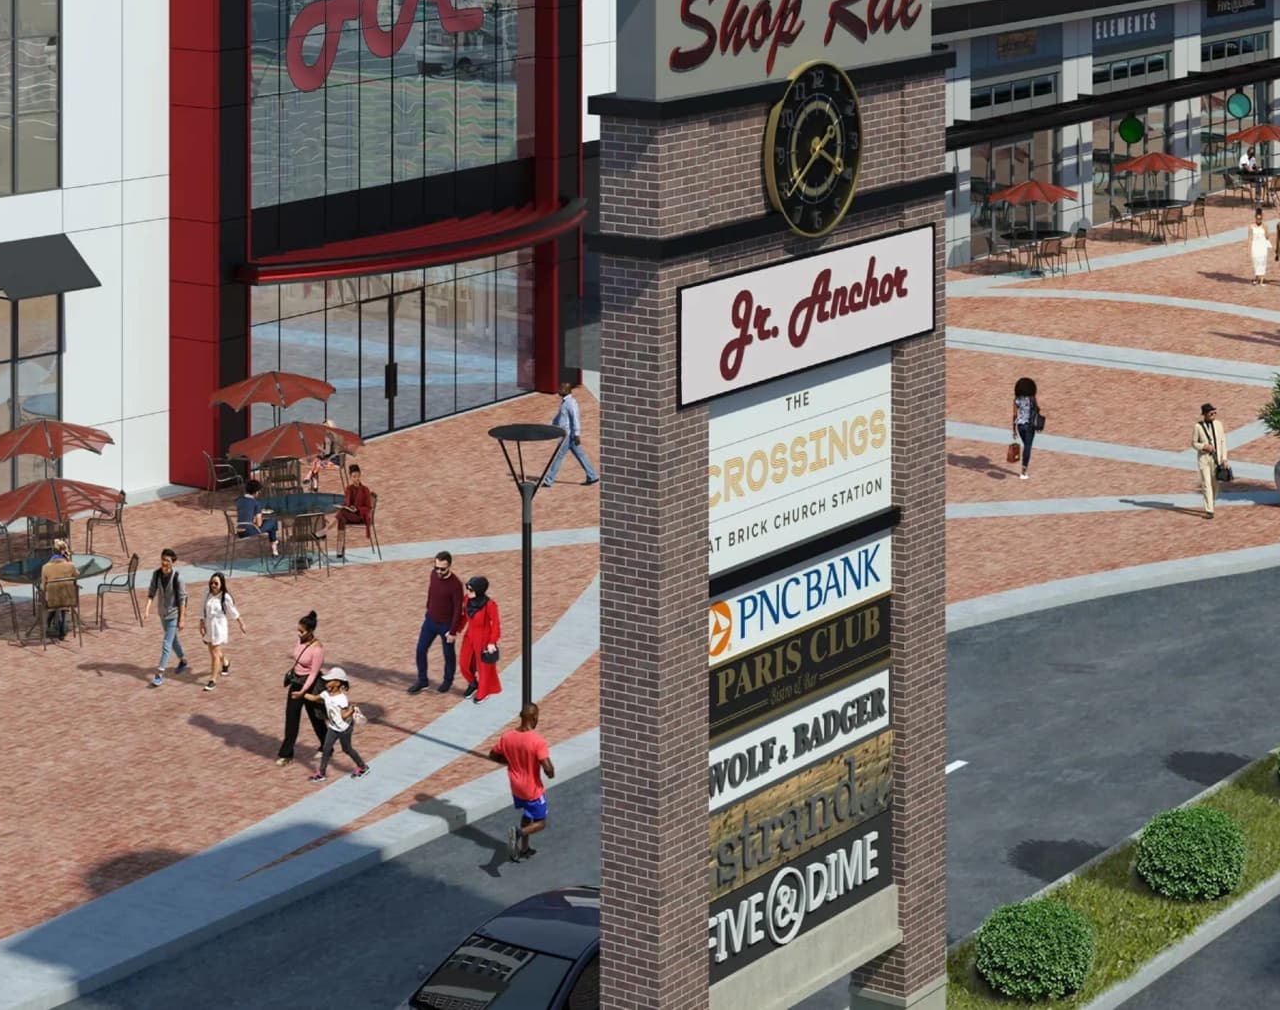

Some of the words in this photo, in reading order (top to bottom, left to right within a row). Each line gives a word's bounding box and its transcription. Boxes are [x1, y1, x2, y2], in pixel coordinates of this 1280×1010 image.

[1096, 12, 1156, 40] ELEMENTS
[811, 70, 825, 89] 12
[719, 289, 780, 382] Jr.
[788, 255, 908, 349] Anchor
[785, 391, 810, 411] THE
[709, 409, 887, 508] CROSSINGS
[728, 518, 768, 547] BRICK
[774, 496, 826, 530] CHURCH
[831, 476, 883, 507] STATION
[716, 639, 801, 707] PARIS
[809, 605, 881, 664] CLUB
[778, 744, 788, 765] &
[792, 687, 887, 759] BADGER
[717, 755, 858, 887] strand
[806, 830, 879, 913] DIME
